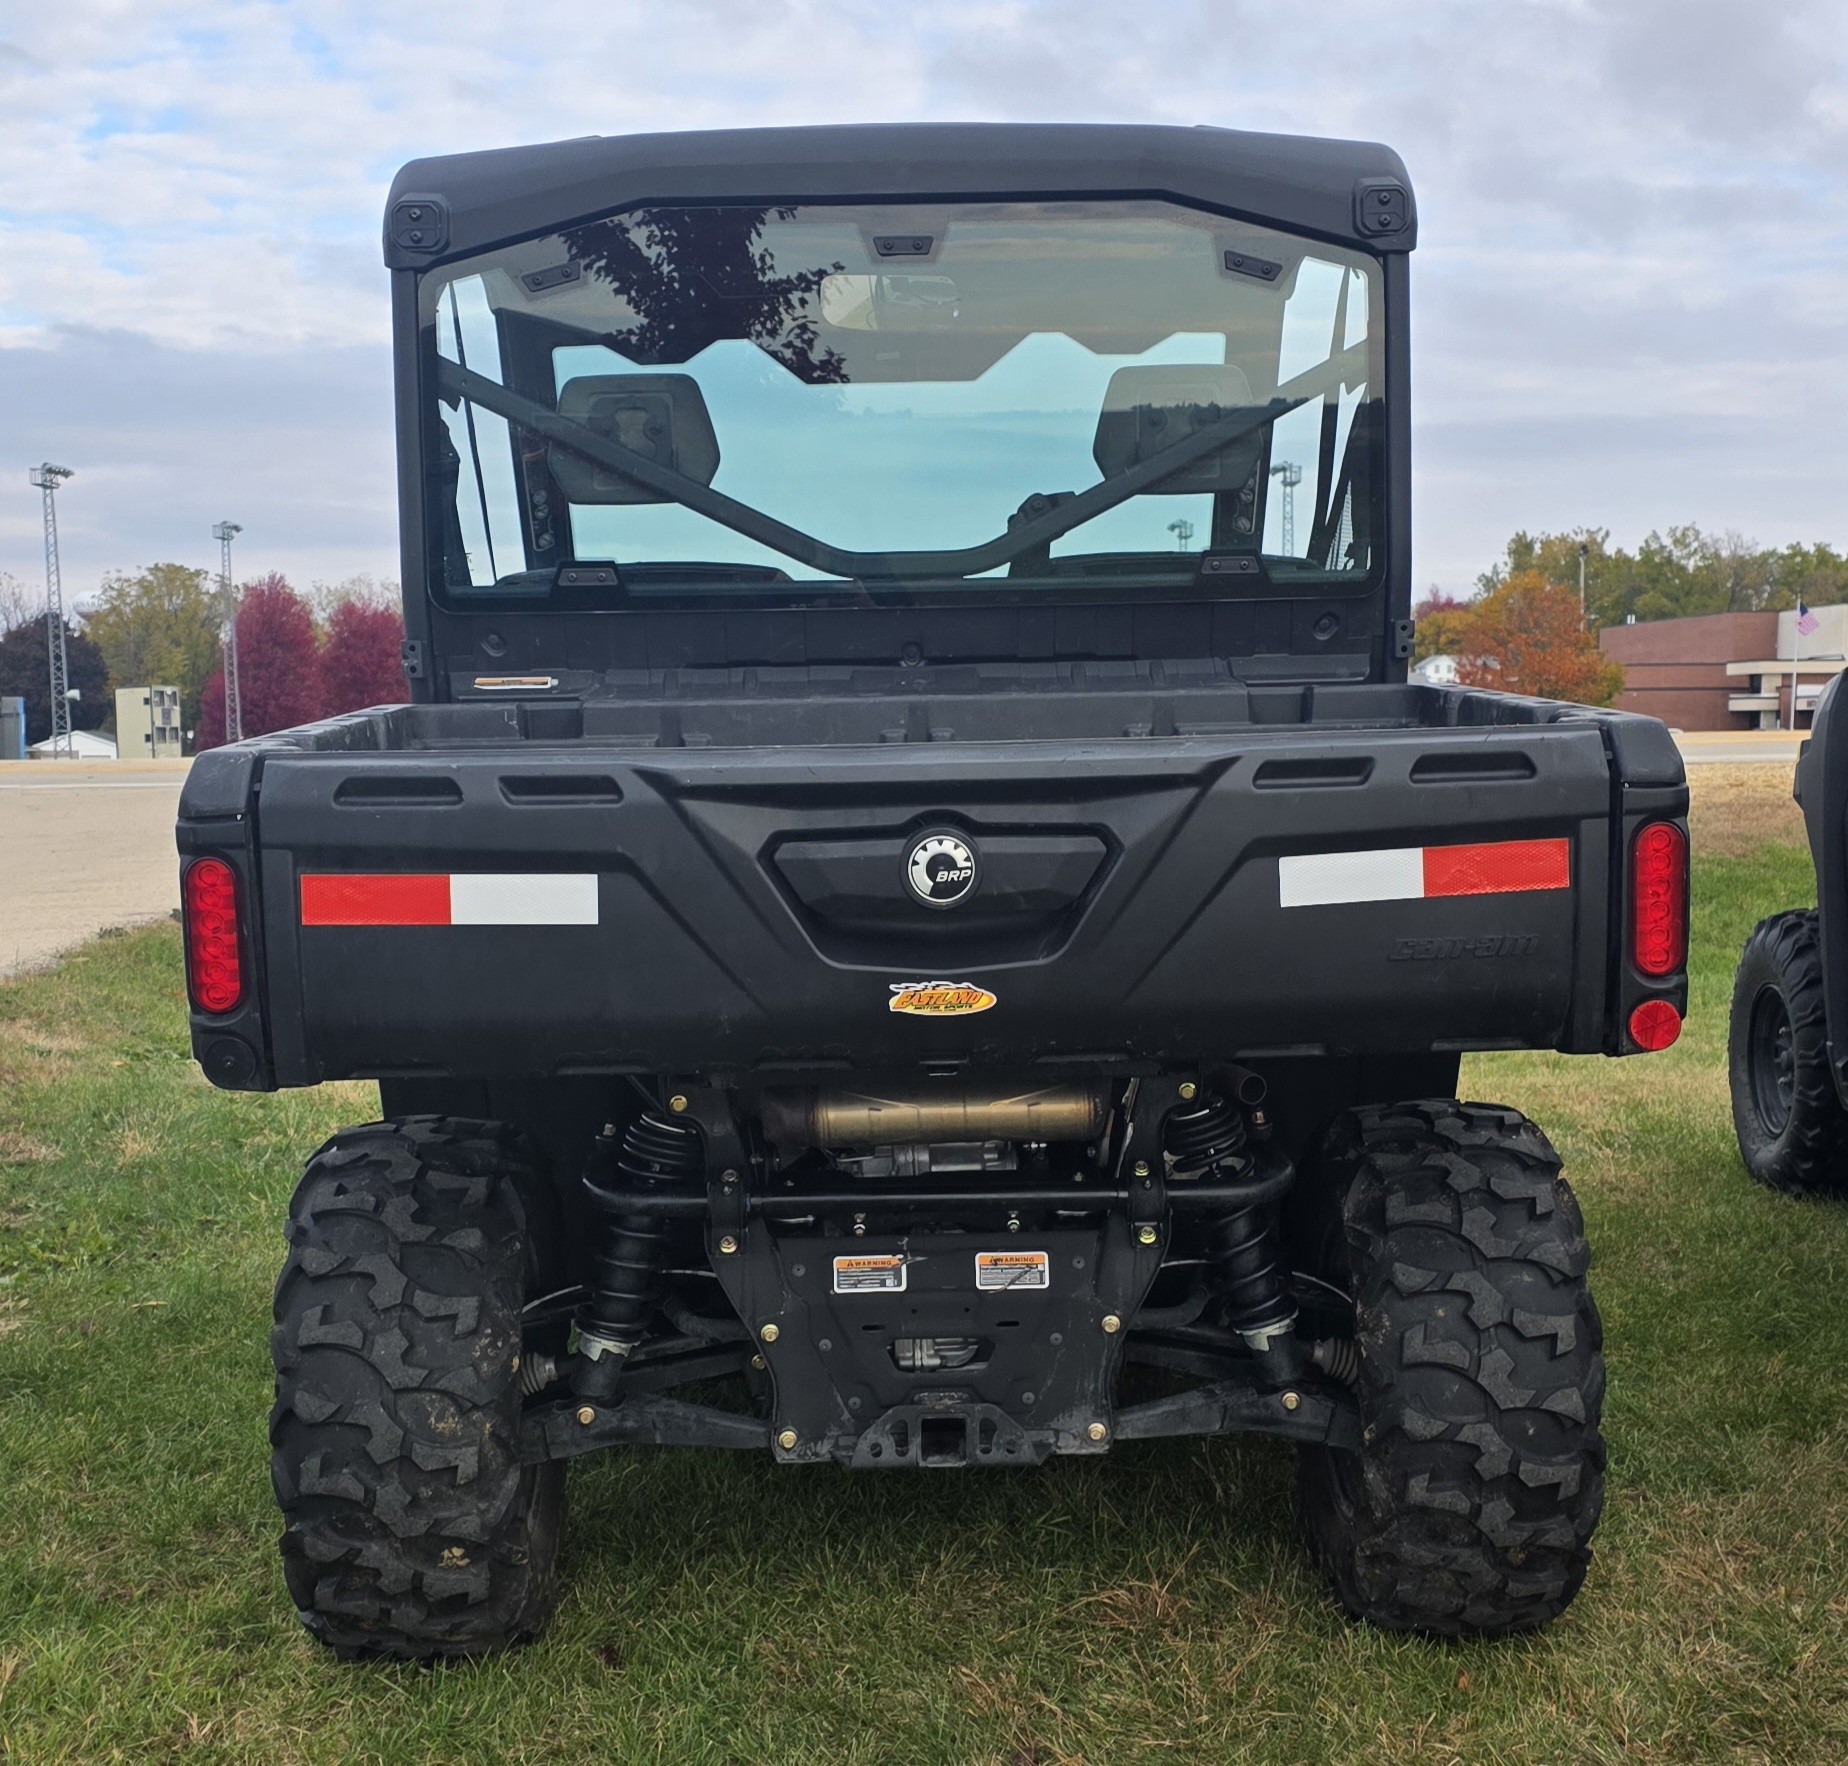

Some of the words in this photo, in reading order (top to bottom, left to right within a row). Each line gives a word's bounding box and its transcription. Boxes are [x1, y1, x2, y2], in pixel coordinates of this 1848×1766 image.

[935, 869, 972, 882] BRP
[1387, 934, 1540, 961] can-am
[893, 990, 984, 1009] EASTLAND
